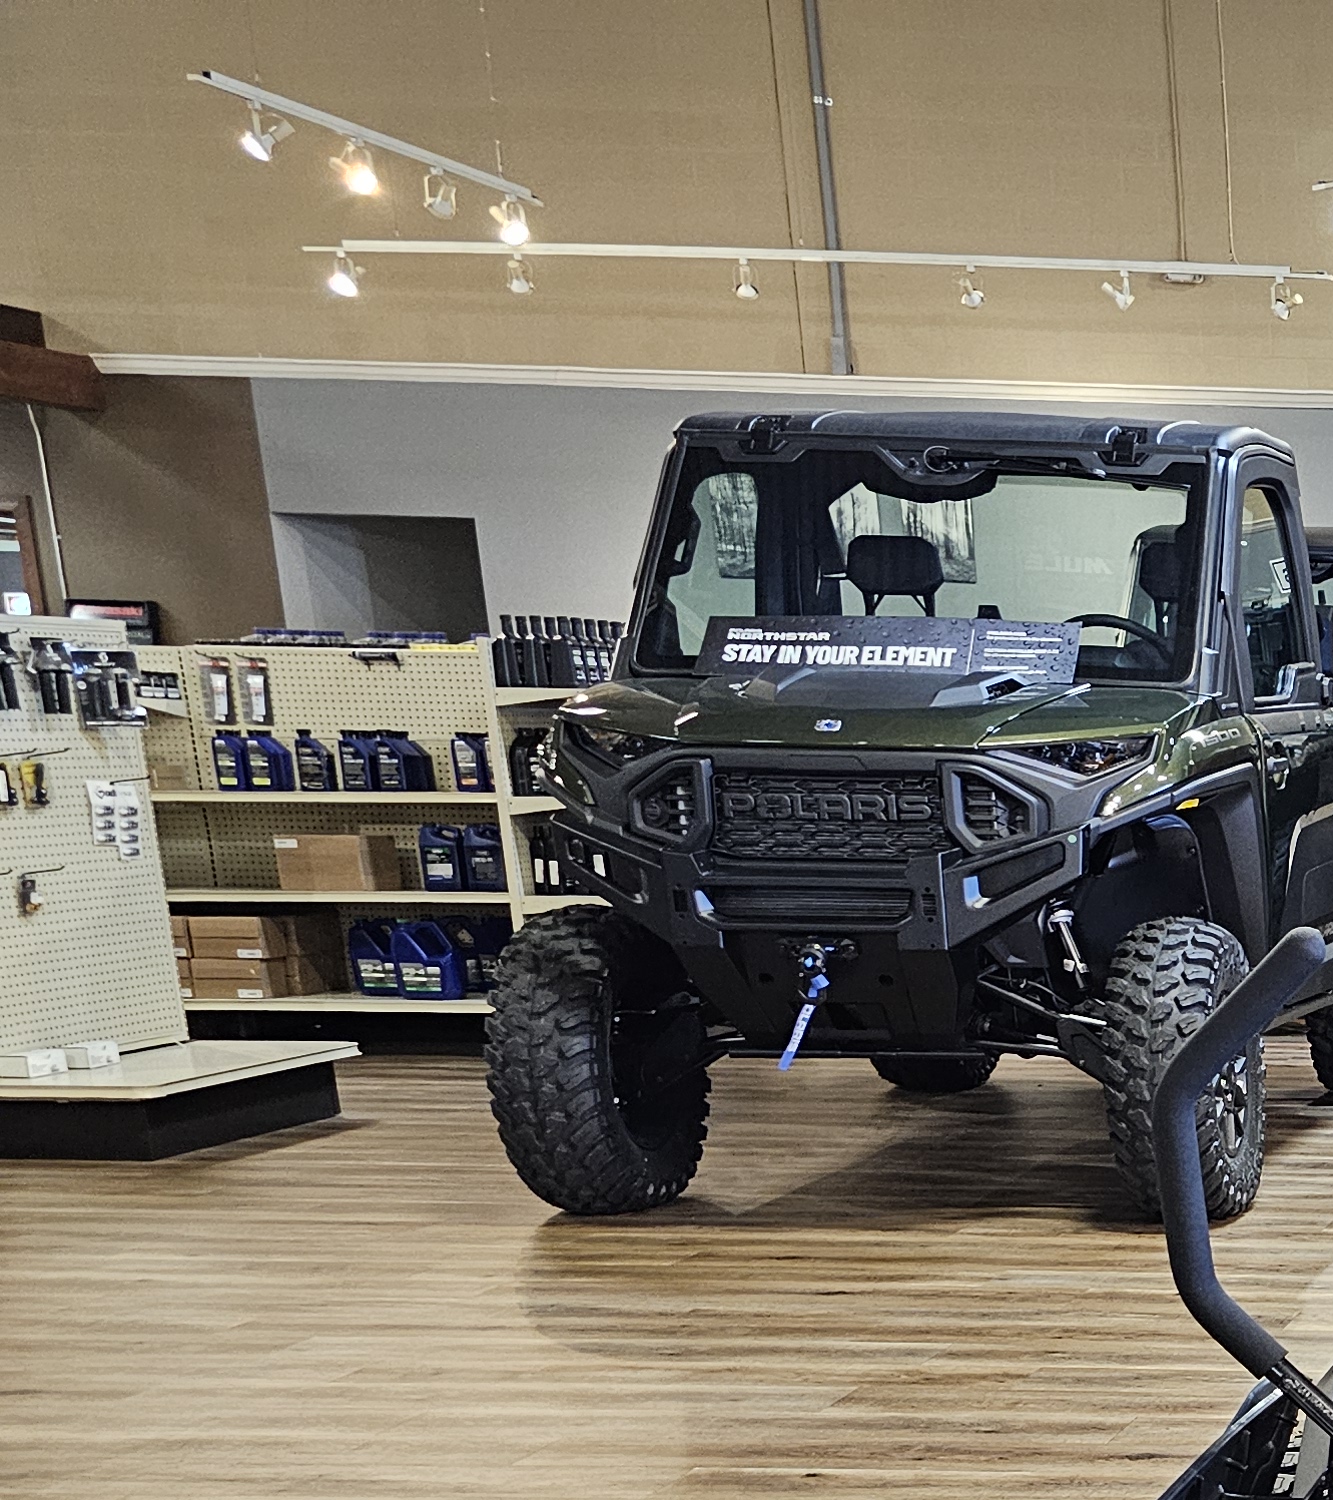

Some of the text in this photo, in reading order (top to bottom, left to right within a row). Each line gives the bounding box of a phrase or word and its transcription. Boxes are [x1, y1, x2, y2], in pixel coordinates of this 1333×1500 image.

[727, 631, 831, 641] NORTHSTAR
[722, 643, 778, 665] STAY
[777, 645, 802, 665] IN
[805, 645, 862, 667] YOUR
[861, 646, 958, 668] ELEMENT
[721, 792, 932, 822] POLARIS
